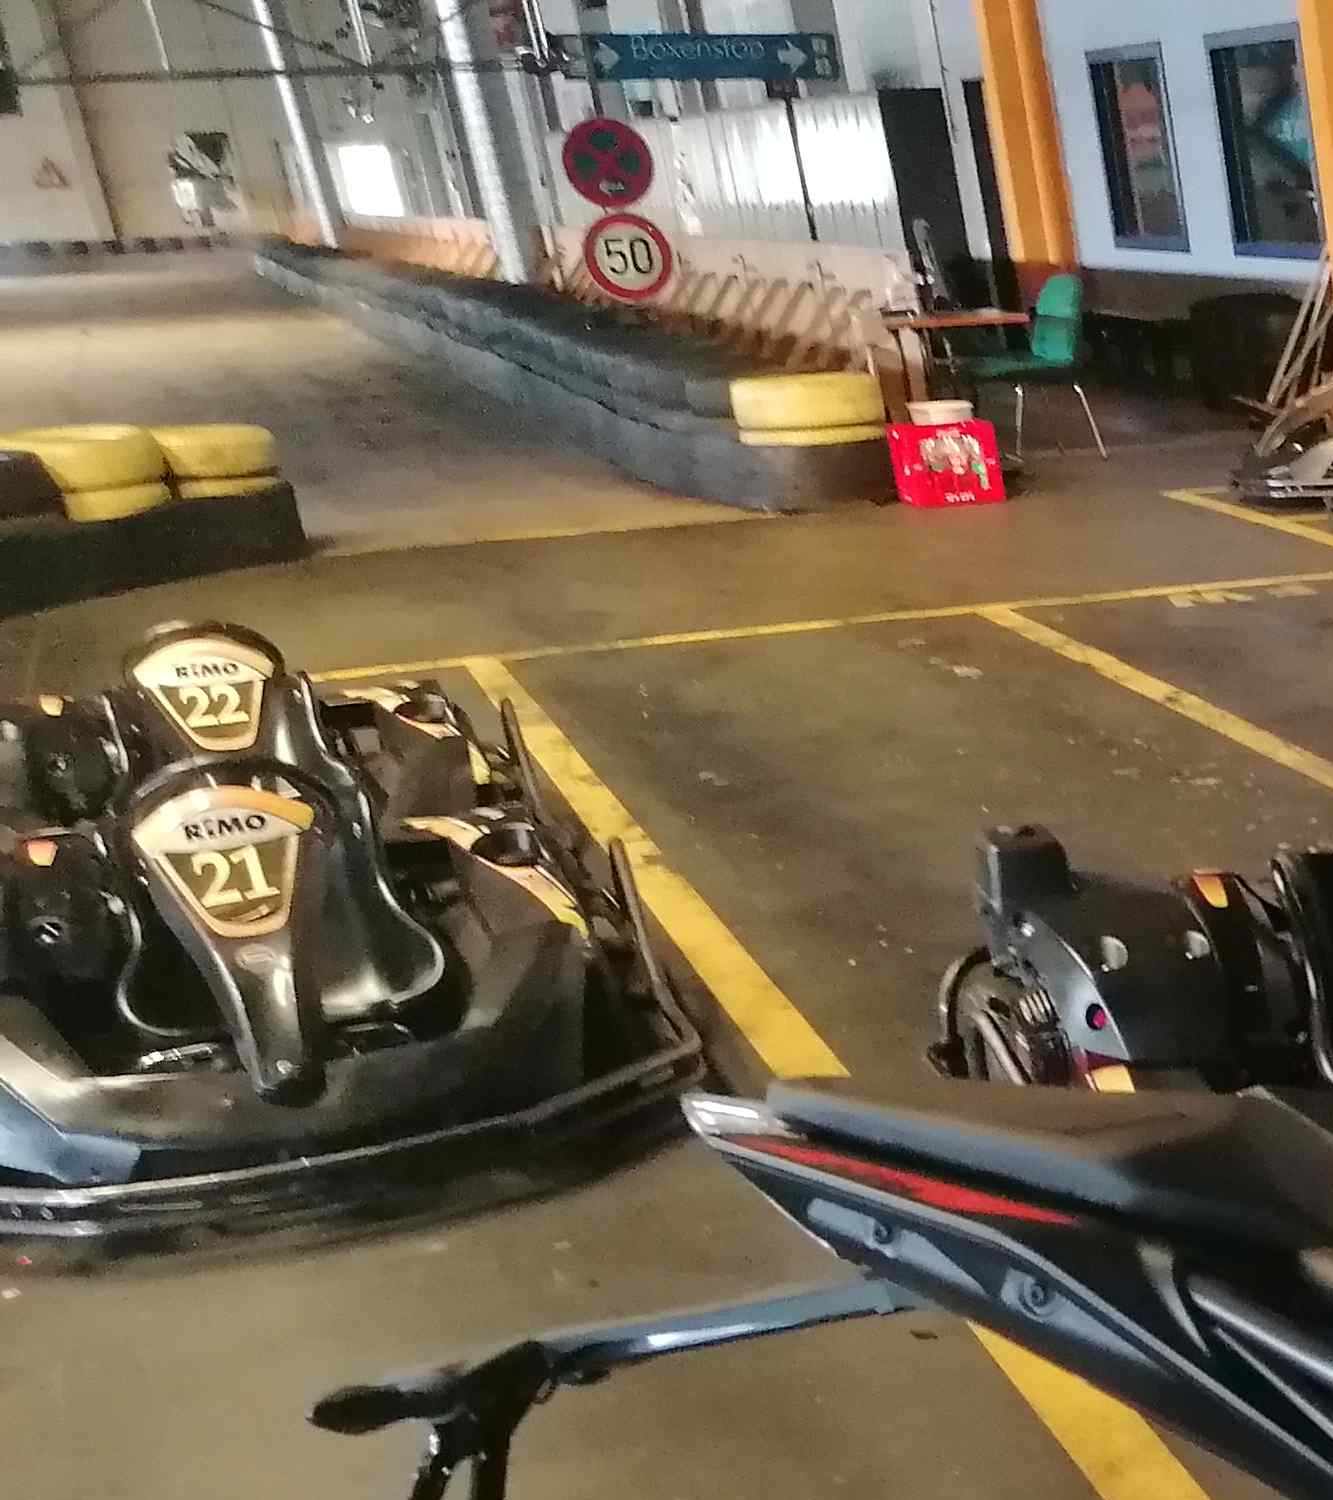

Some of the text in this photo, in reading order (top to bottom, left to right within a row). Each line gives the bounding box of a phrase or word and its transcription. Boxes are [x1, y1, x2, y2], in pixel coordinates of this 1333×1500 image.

[604, 238, 653, 274] 50
[179, 683, 250, 729] 22
[190, 845, 281, 909] 21
